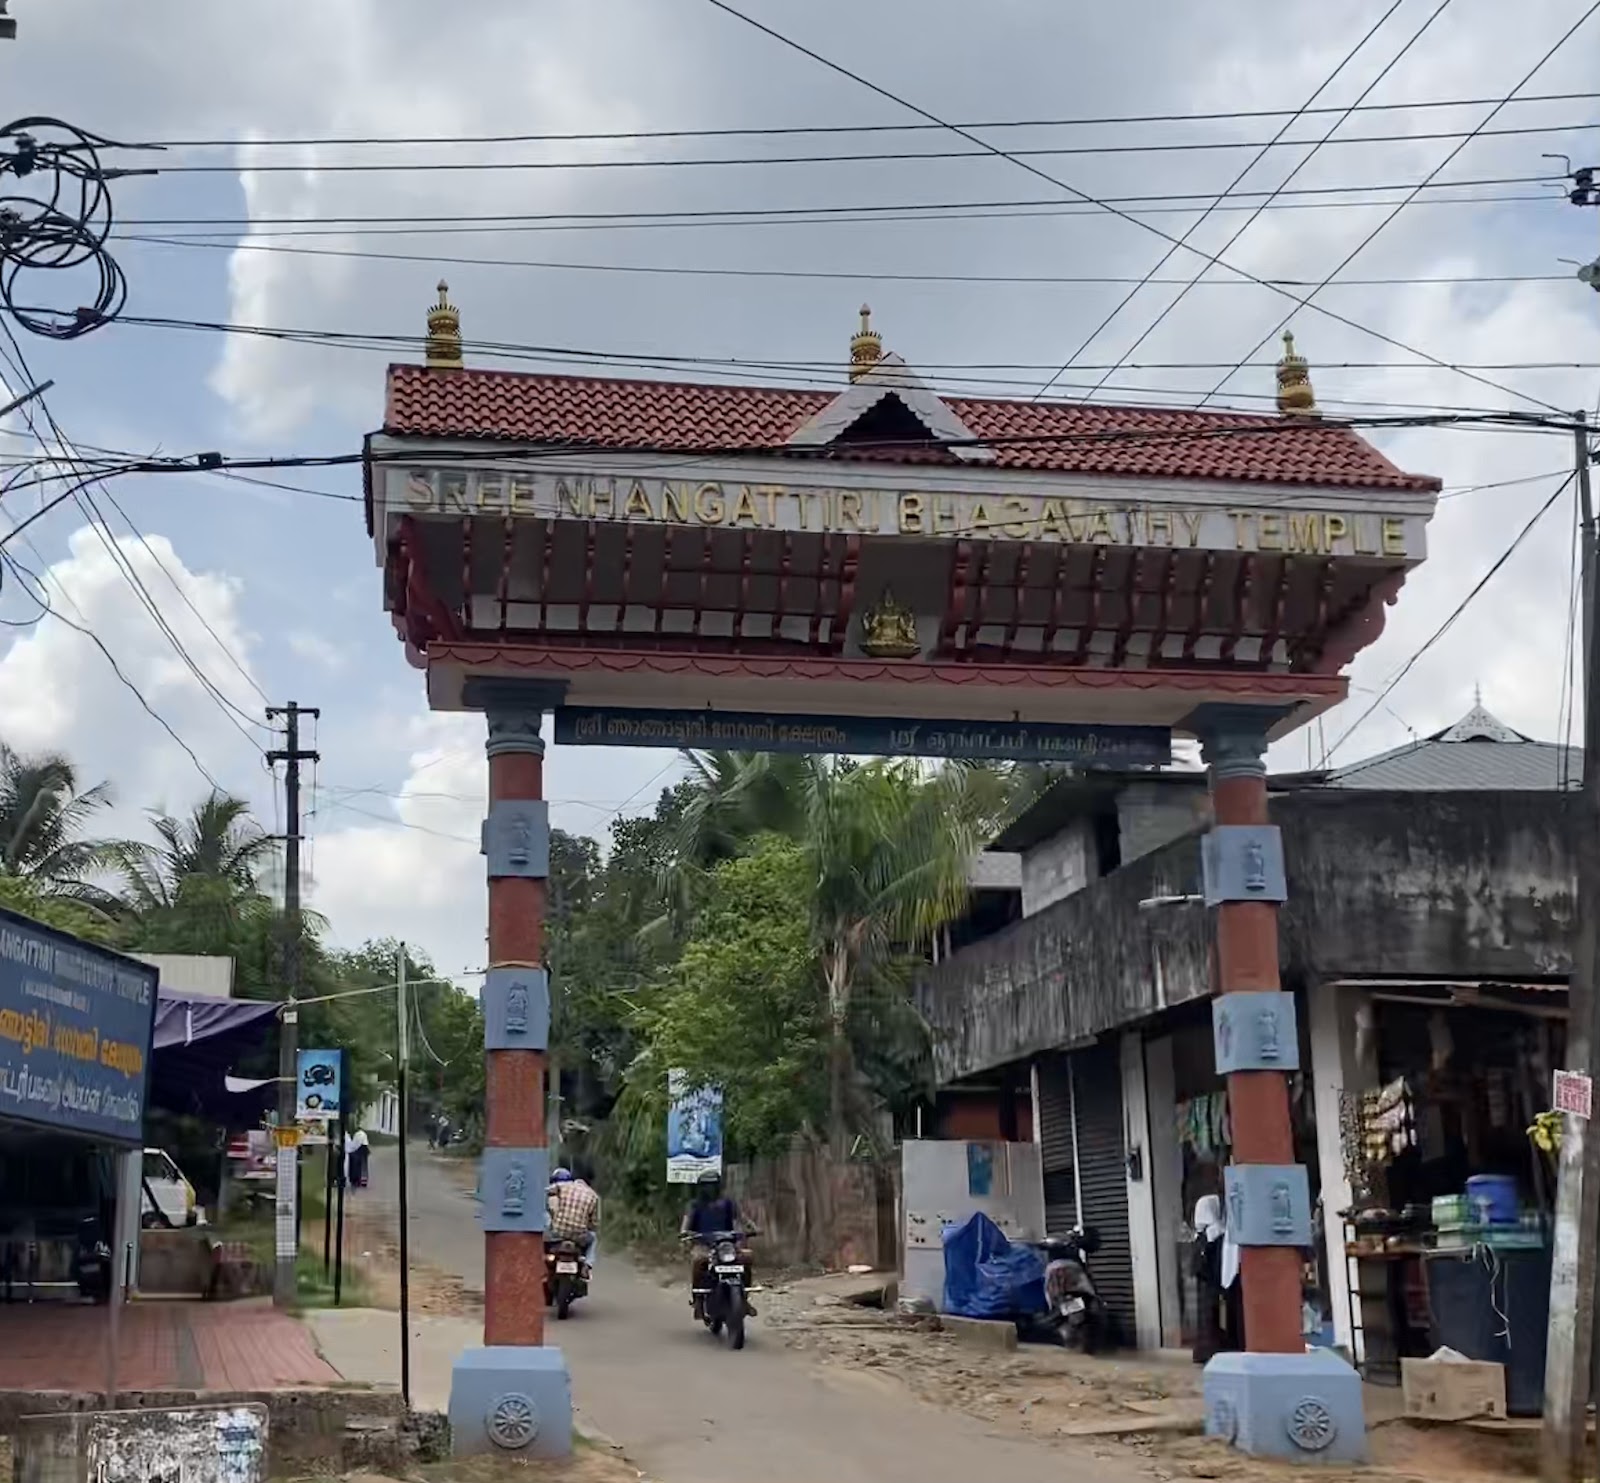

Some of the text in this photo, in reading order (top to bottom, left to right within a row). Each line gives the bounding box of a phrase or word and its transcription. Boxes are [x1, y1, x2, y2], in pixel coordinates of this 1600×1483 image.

[406, 469, 535, 514] SREE
[554, 476, 880, 534] NHANGATTIRI
[1227, 507, 1407, 557] TEMPLE
